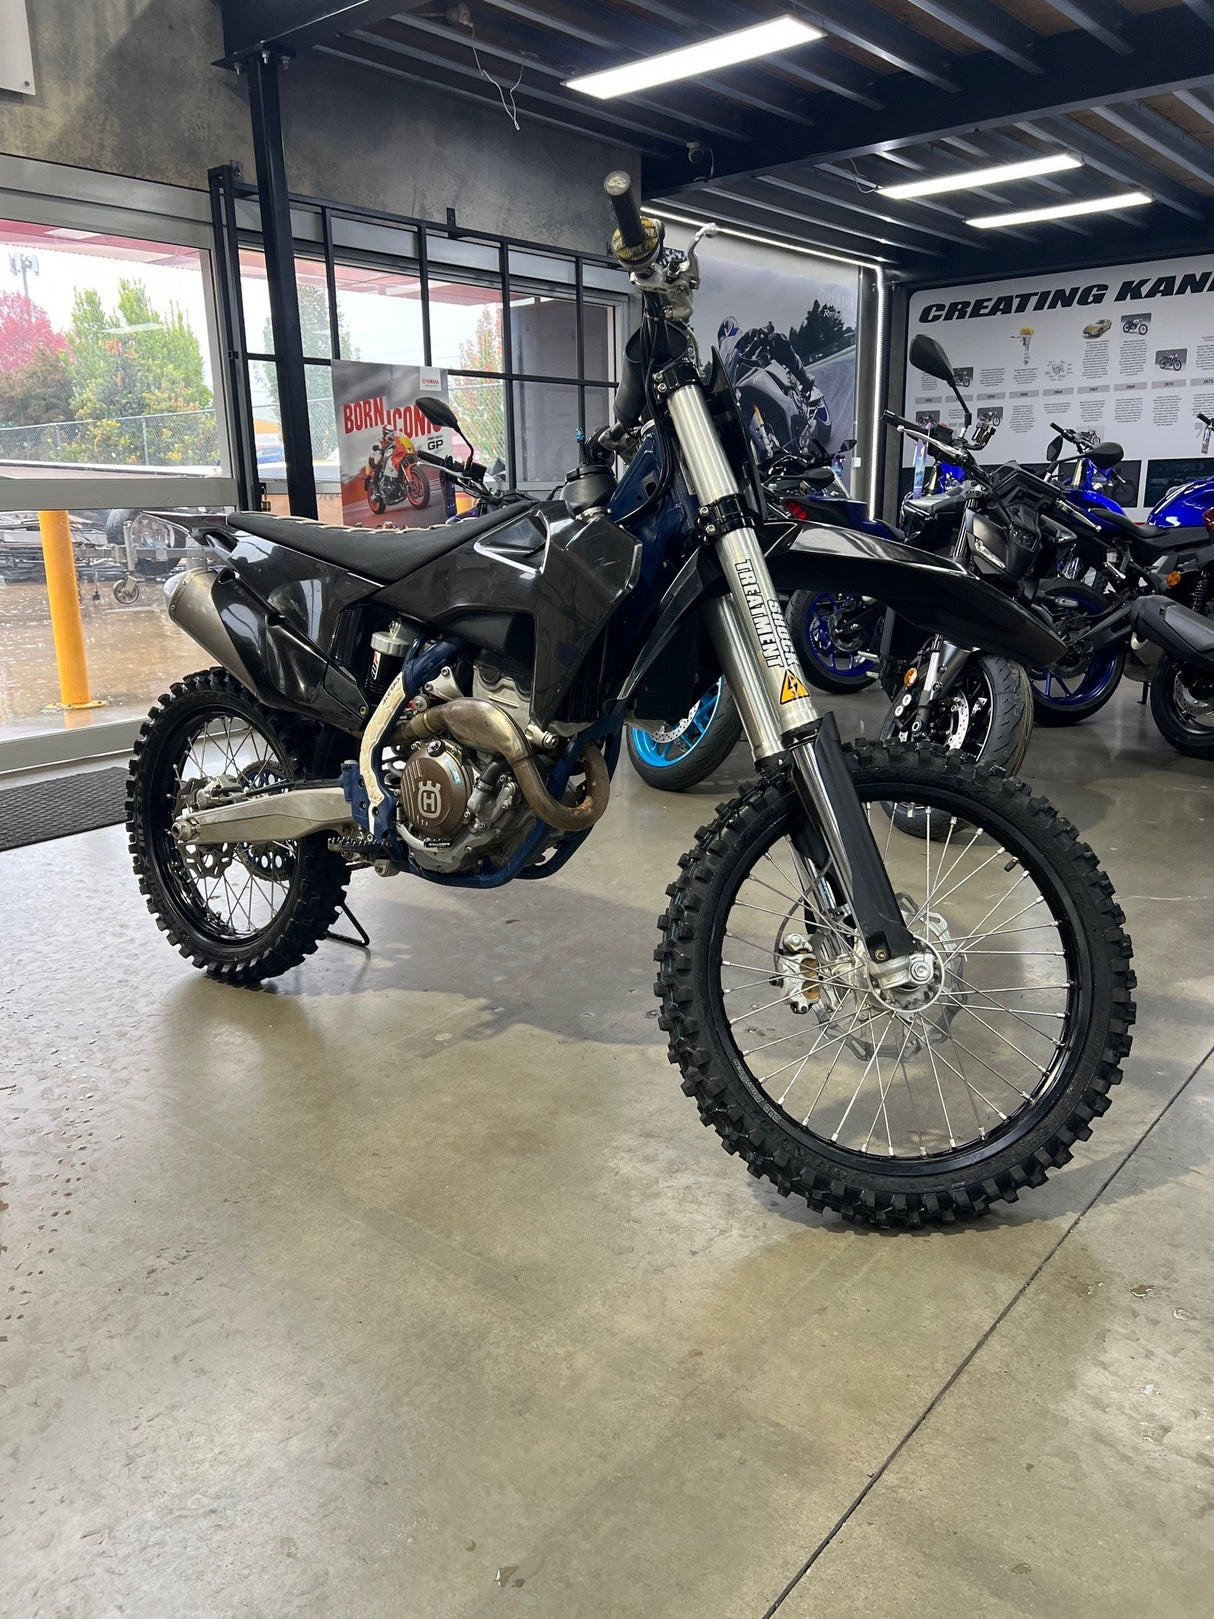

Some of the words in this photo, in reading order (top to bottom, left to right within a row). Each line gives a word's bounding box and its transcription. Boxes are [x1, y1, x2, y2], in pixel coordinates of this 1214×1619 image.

[918, 283, 1109, 324] CREATING
[1114, 271, 1214, 302] KAN
[343, 397, 385, 434] BORN
[386, 405, 441, 439] ICON
[428, 440, 443, 450] GP
[735, 558, 784, 669] TREATMENT
[767, 600, 800, 667] SHOCK
